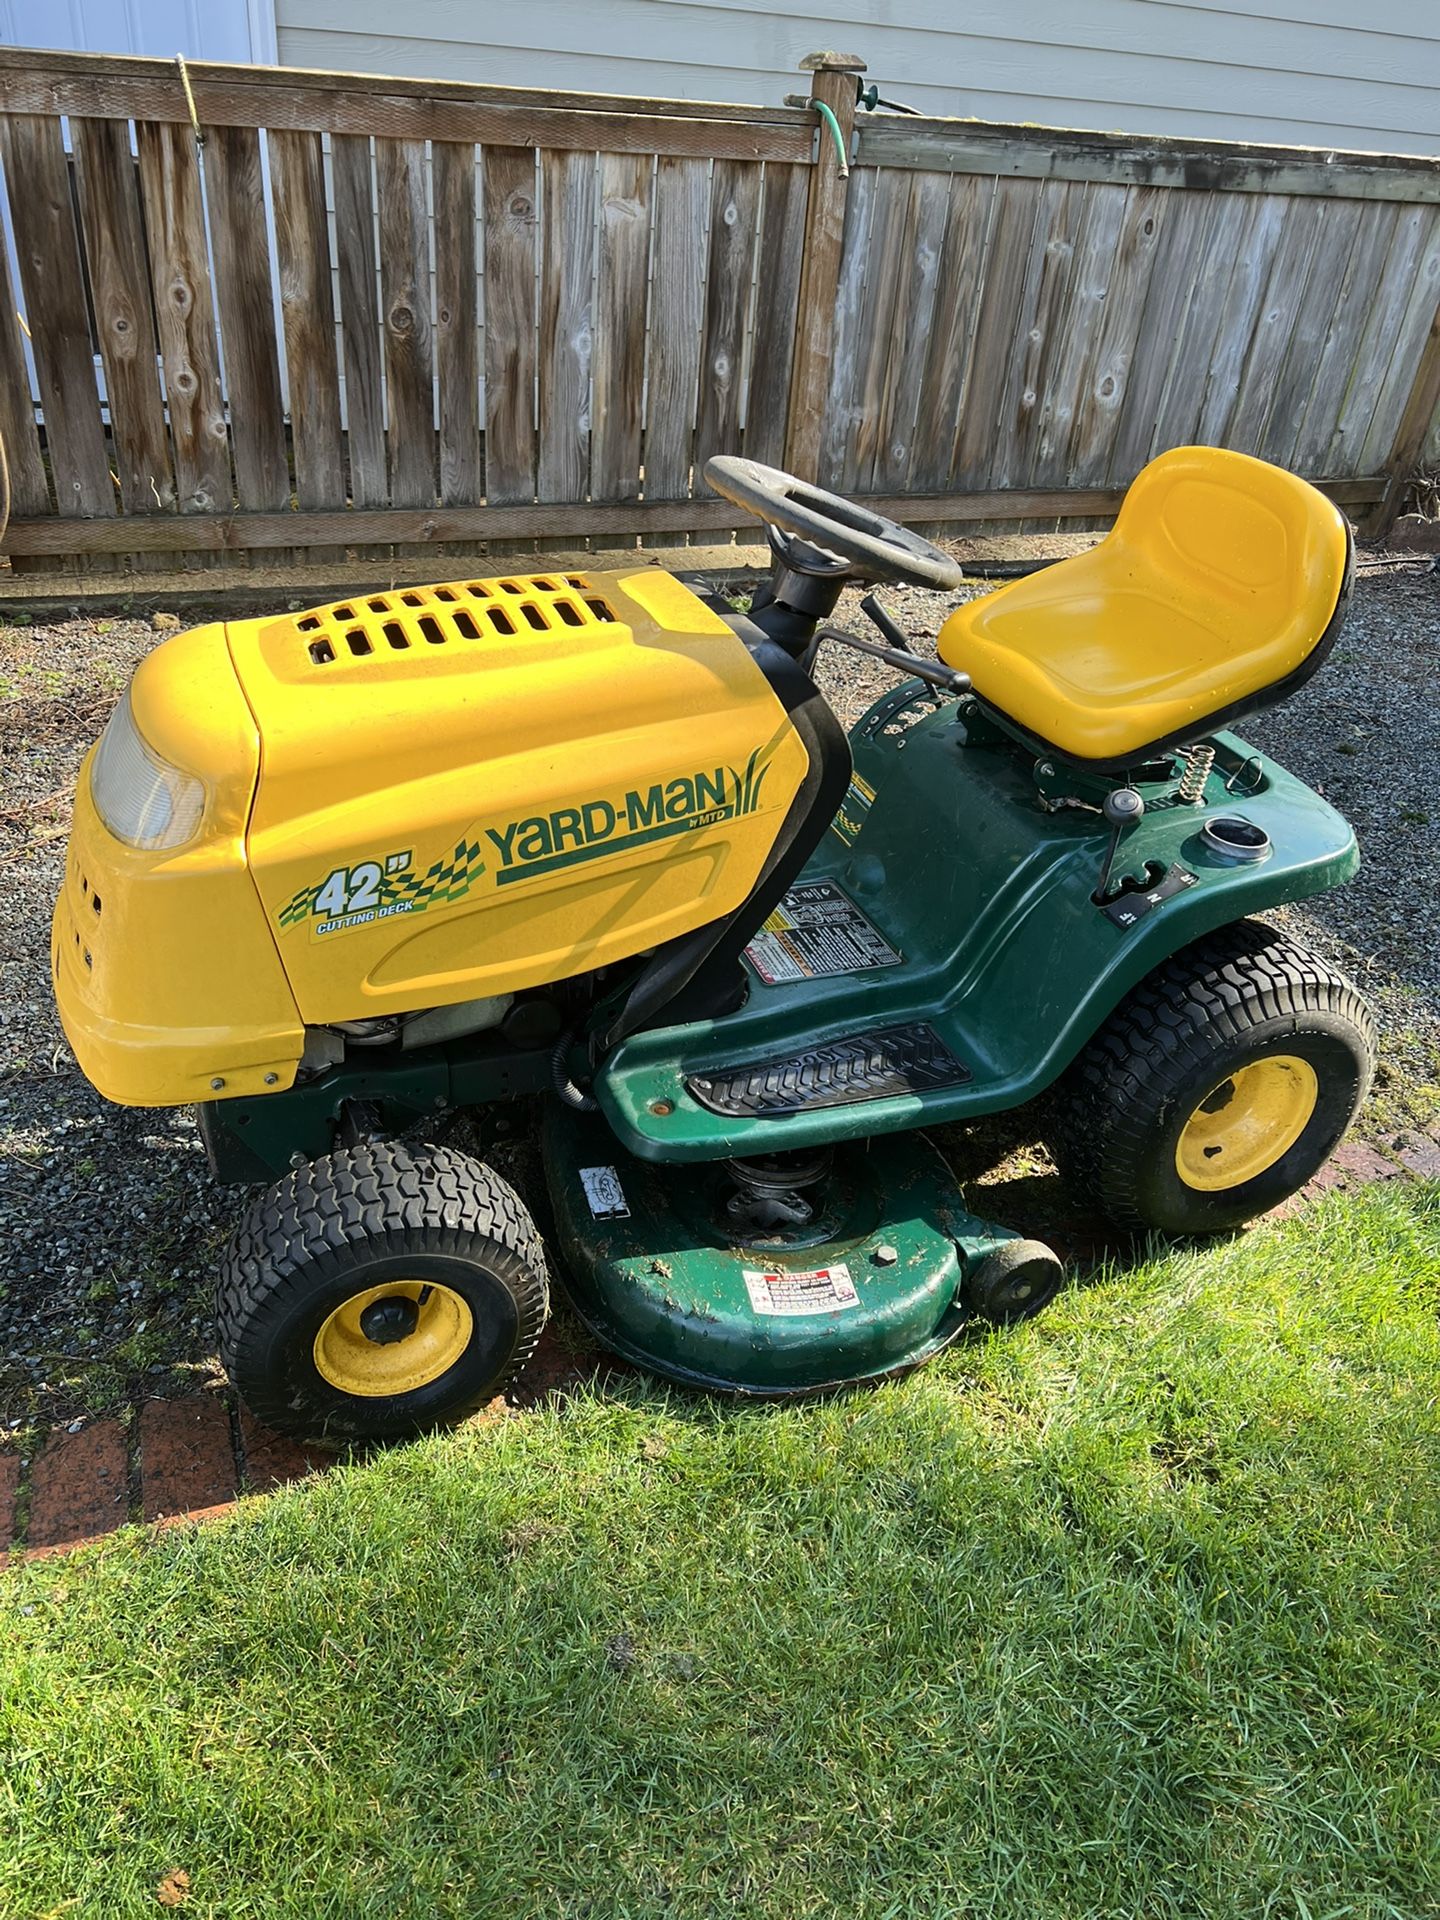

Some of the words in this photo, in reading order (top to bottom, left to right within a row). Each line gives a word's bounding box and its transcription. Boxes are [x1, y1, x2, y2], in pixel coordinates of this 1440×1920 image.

[699, 809, 726, 826] MTD
[1147, 893, 1162, 903] N
[317, 911, 375, 935] CUTTING
[379, 900, 414, 918] DECK
[1119, 912, 1133, 921] F
